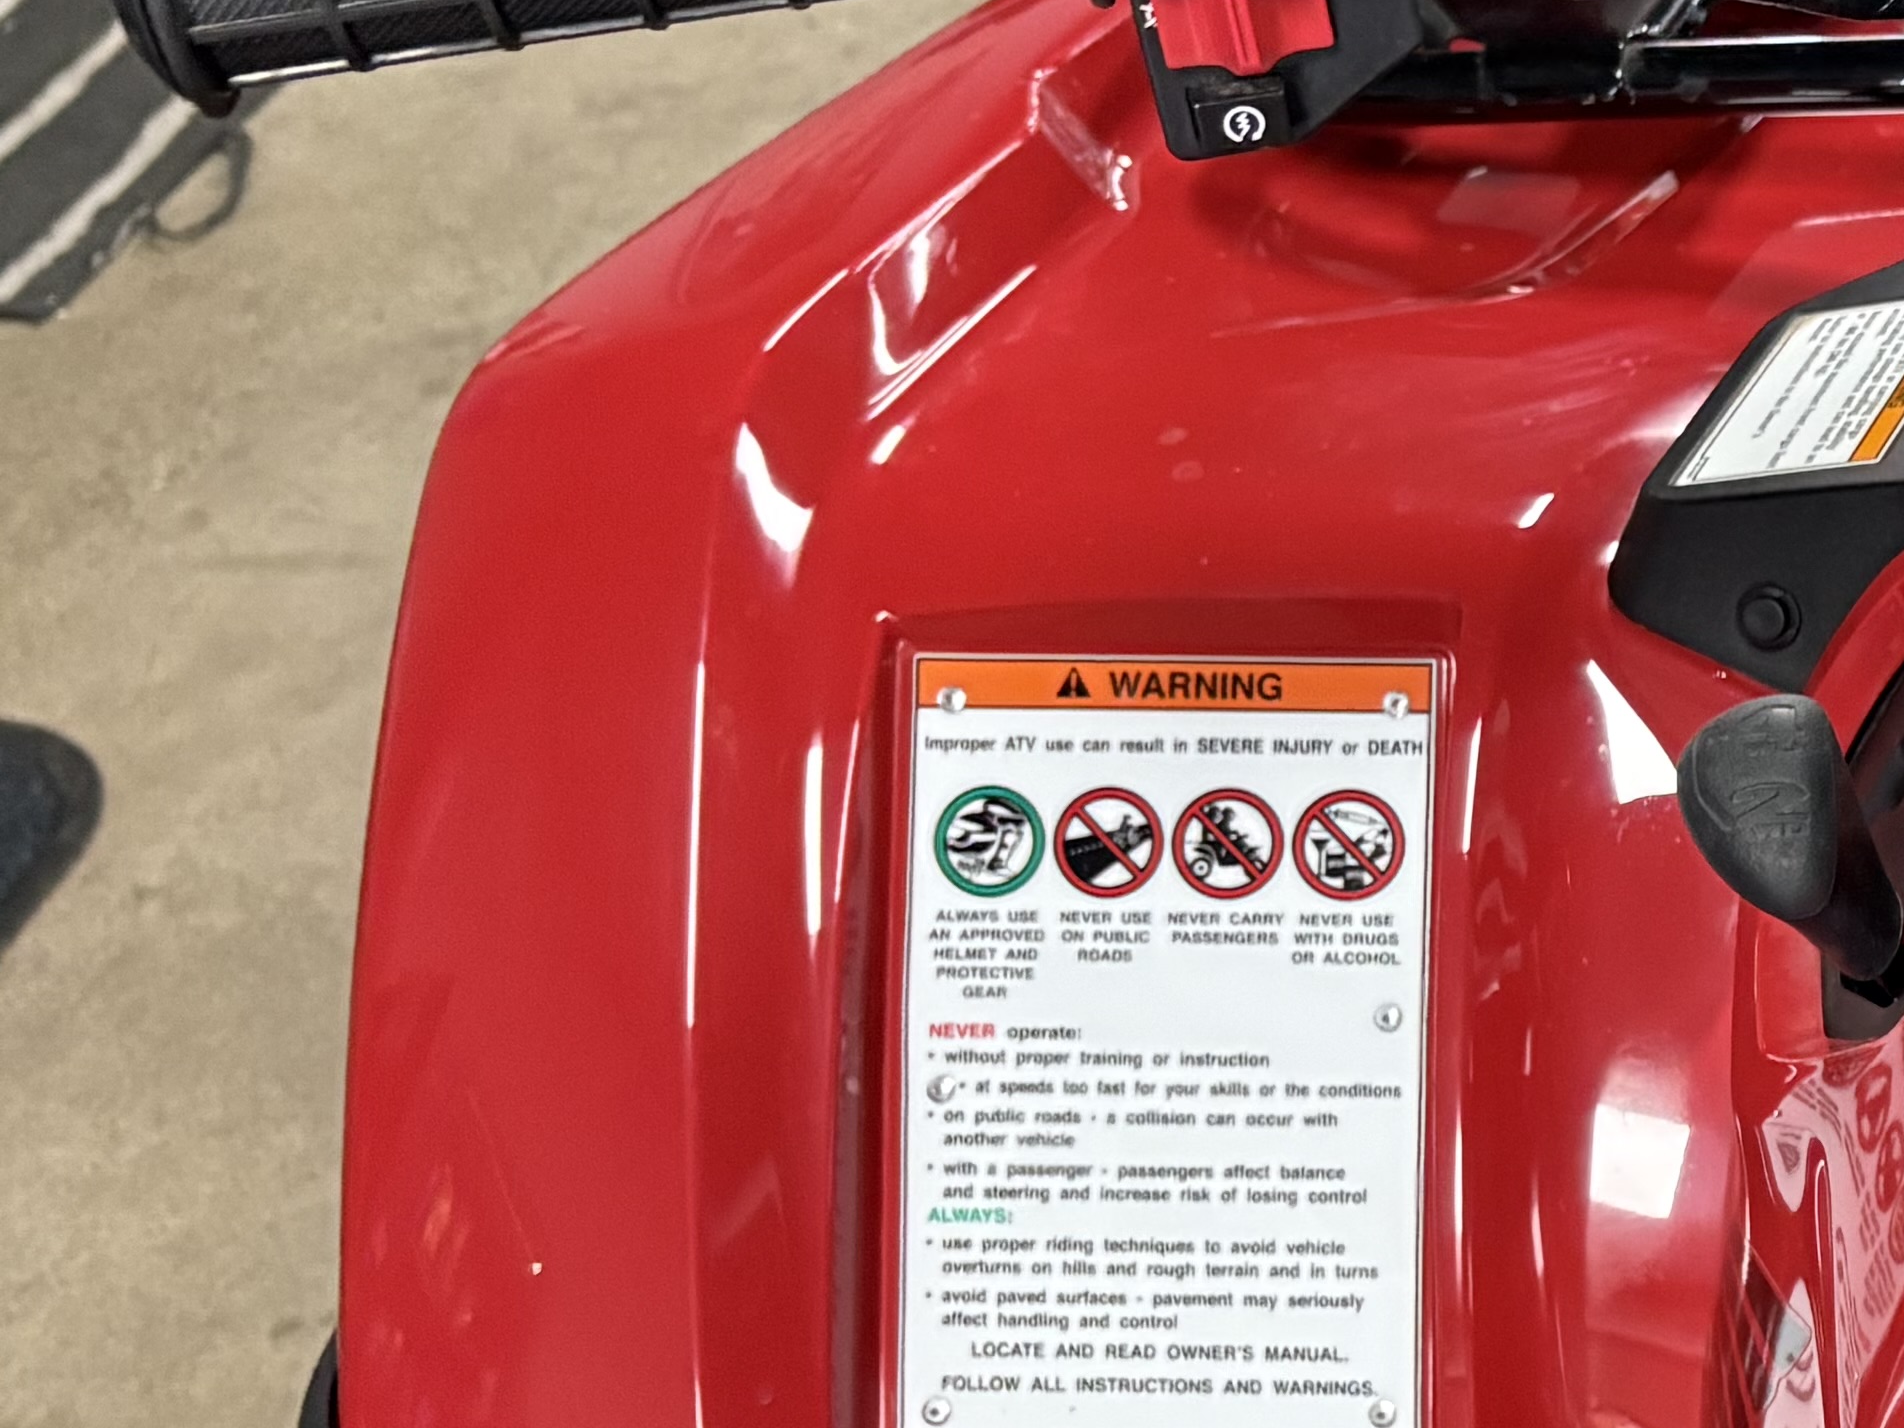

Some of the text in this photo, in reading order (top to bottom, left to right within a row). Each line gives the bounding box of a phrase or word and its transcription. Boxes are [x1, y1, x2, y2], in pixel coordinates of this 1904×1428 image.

[1109, 672, 1283, 701] WARNING
[924, 735, 1423, 756] Improper ATV use can result in SEVERE INJURY or DEATH
[934, 909, 1039, 924] ALWAYS USE
[1058, 911, 1153, 925] NEVER USE
[1167, 912, 1285, 926] NEVER CARRY
[1298, 913, 1395, 927] NEVER USE
[1060, 929, 1151, 944] ON PUBLIC
[1170, 930, 1280, 945] PASSENGERS
[1292, 932, 1400, 946] WITH DRUGS
[932, 947, 1041, 961] HELMET AND
[1290, 951, 1402, 966] OR ALCOHOL
[961, 986, 1009, 999] GEAR
[928, 1023, 1082, 1042] NEVER operate:
[944, 1050, 1271, 1070] without proper training or instruction
[943, 1109, 1339, 1127] on public roads a collision can occur with
[943, 1132, 1076, 1148] another vehicle
[942, 1184, 1368, 1208] and steering and increase risk of losing control
[926, 1207, 1014, 1225] ALWAYS:
[942, 1236, 1346, 1256] use proper riding techniques to avoid vehicle
[941, 1260, 1379, 1281] overturns on hills and rough terrain and in turns
[941, 1289, 1365, 1313] avoid paved surfaces pavement may seriously
[941, 1311, 1178, 1331] affect handling and control
[970, 1341, 1350, 1362] LOCATE AND READ OWNER'S MANUAL.
[940, 1375, 1379, 1397] FOLLOW ALL INSTRUCTIONS AND WARNINGS.
